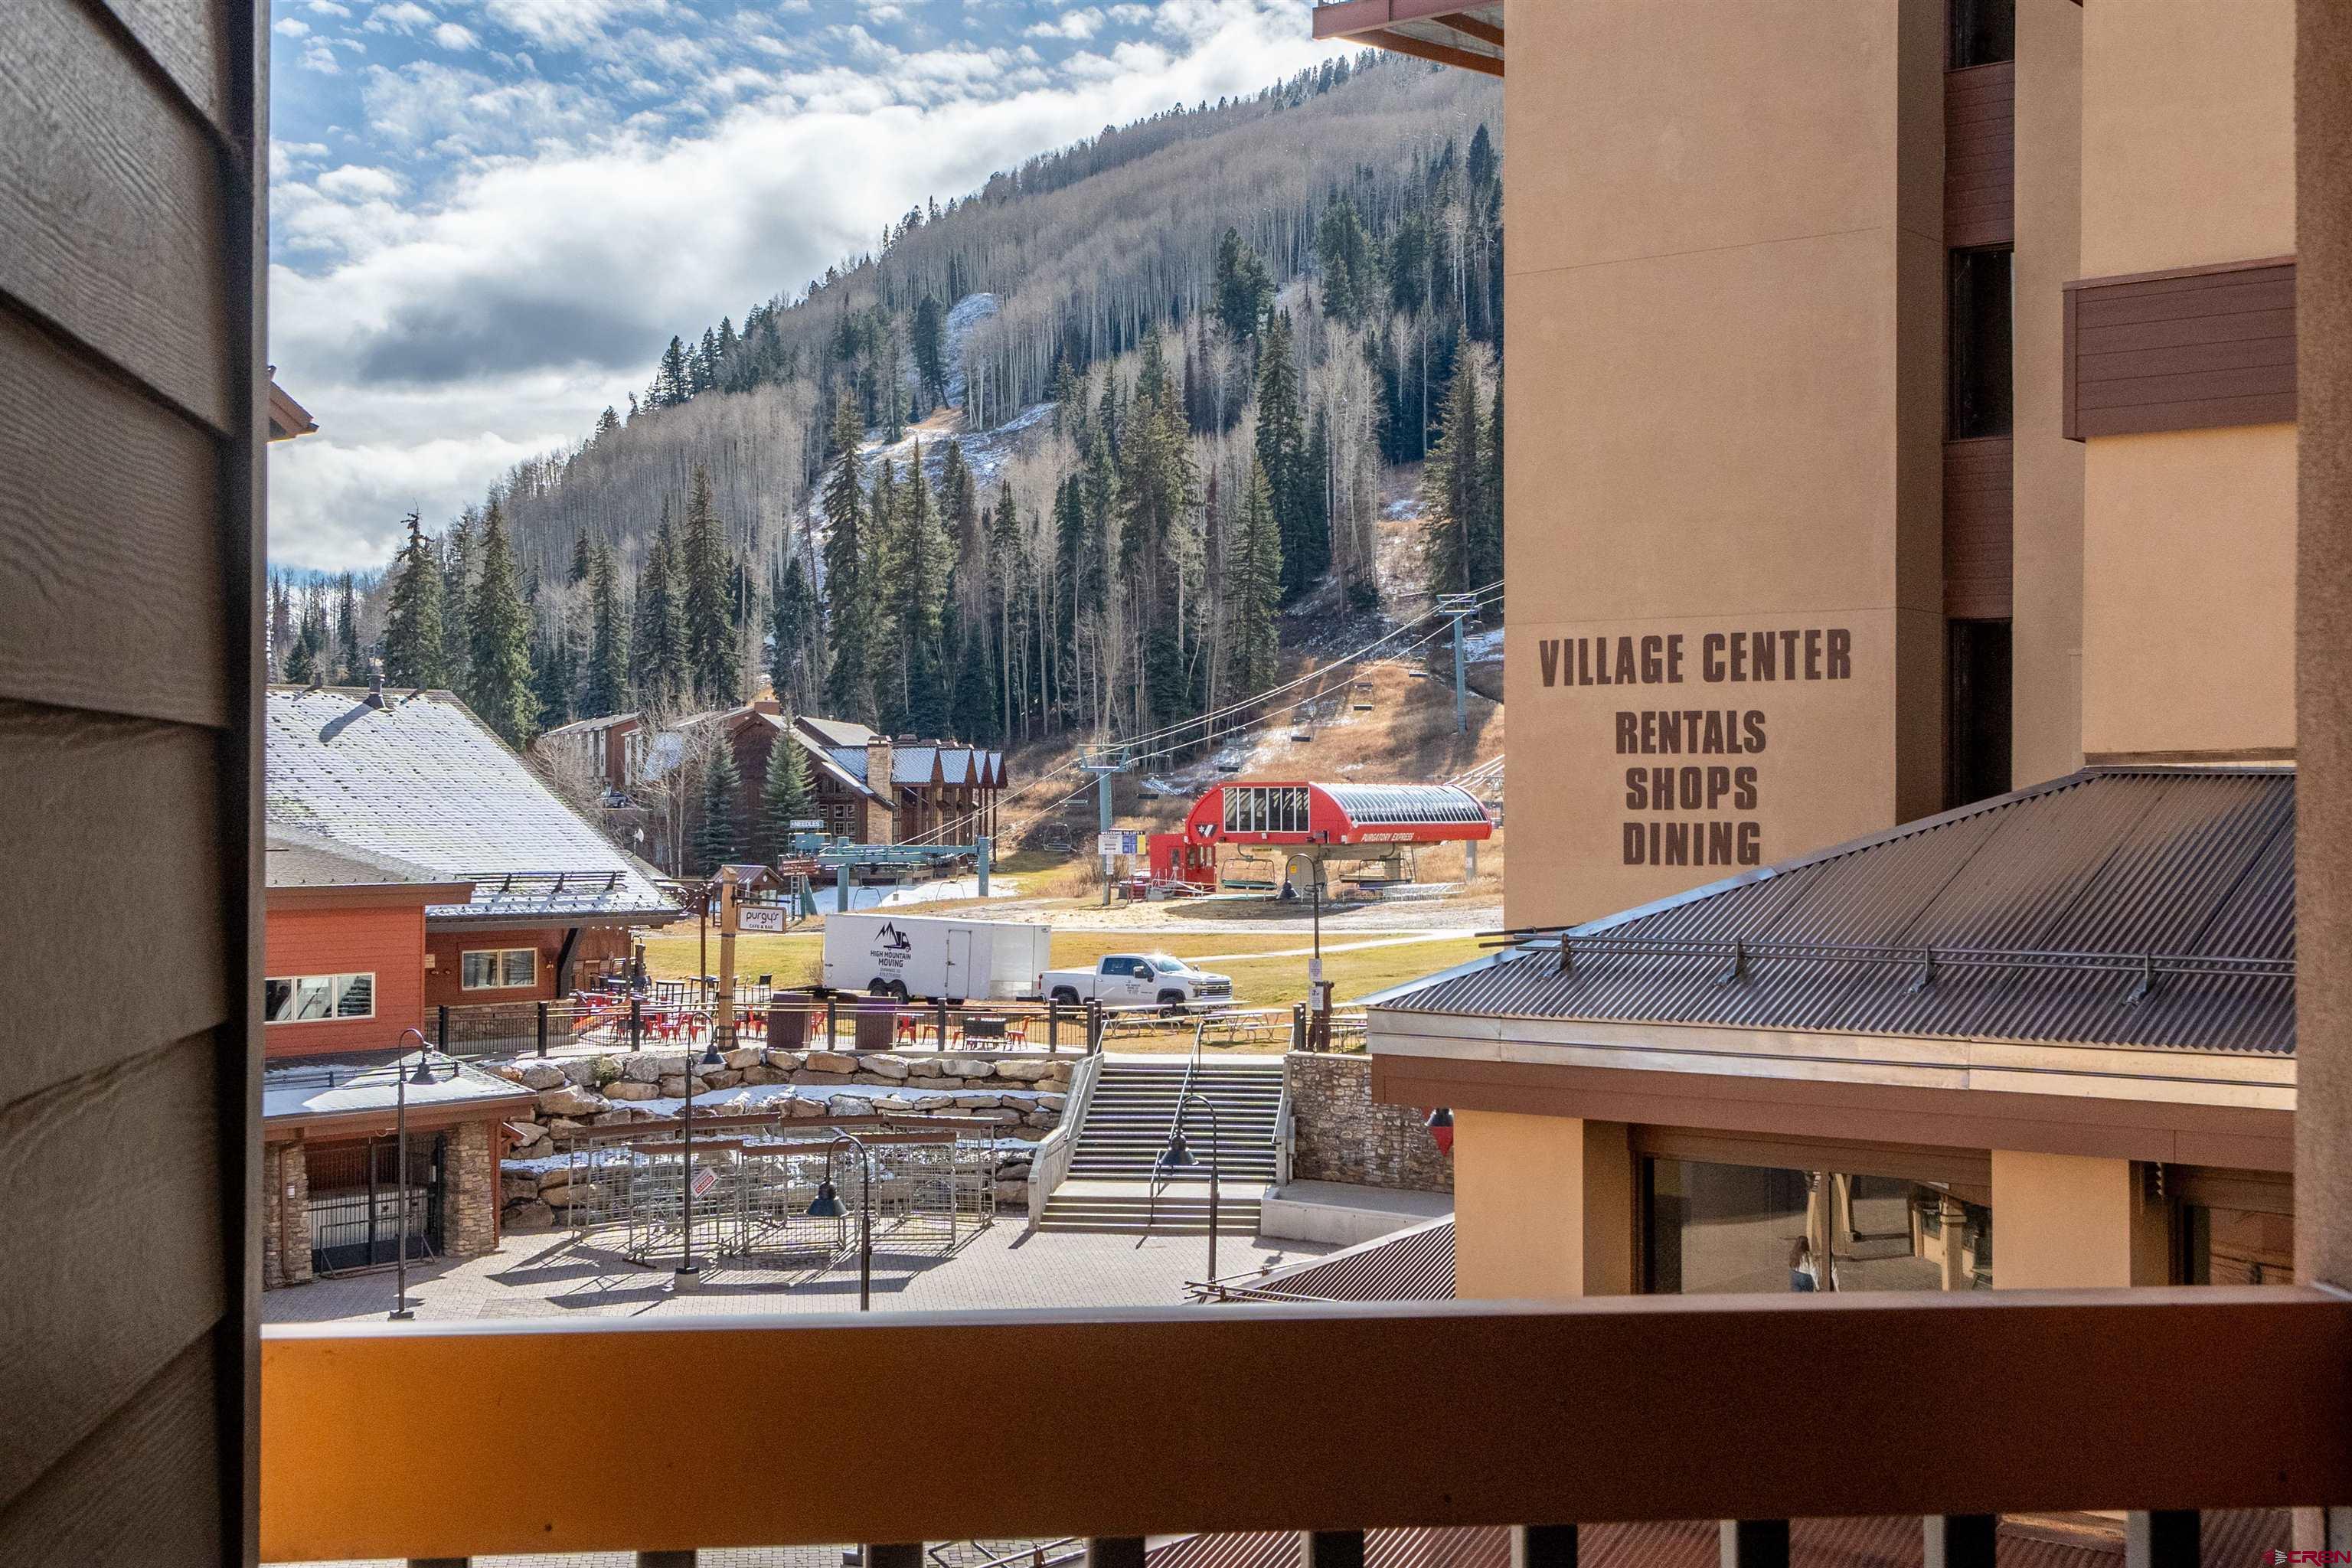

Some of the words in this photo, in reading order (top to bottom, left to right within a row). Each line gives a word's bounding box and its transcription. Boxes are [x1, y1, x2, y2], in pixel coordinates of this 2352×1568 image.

[1539, 633, 1684, 688] VILLAGE
[1702, 628, 1852, 683] CENTER
[1615, 710, 1766, 754] RENTALS
[1625, 766, 1758, 811] SHOPS
[1361, 833, 1392, 842] PURGATORY
[1391, 832, 1415, 841] EXPRESS
[1623, 822, 1761, 866] DINING
[746, 911, 779, 923] purgy's
[878, 958, 903, 968] MOVING
[884, 952, 912, 961] MOUNTAIN
[696, 1175, 714, 1192] CLOSED
